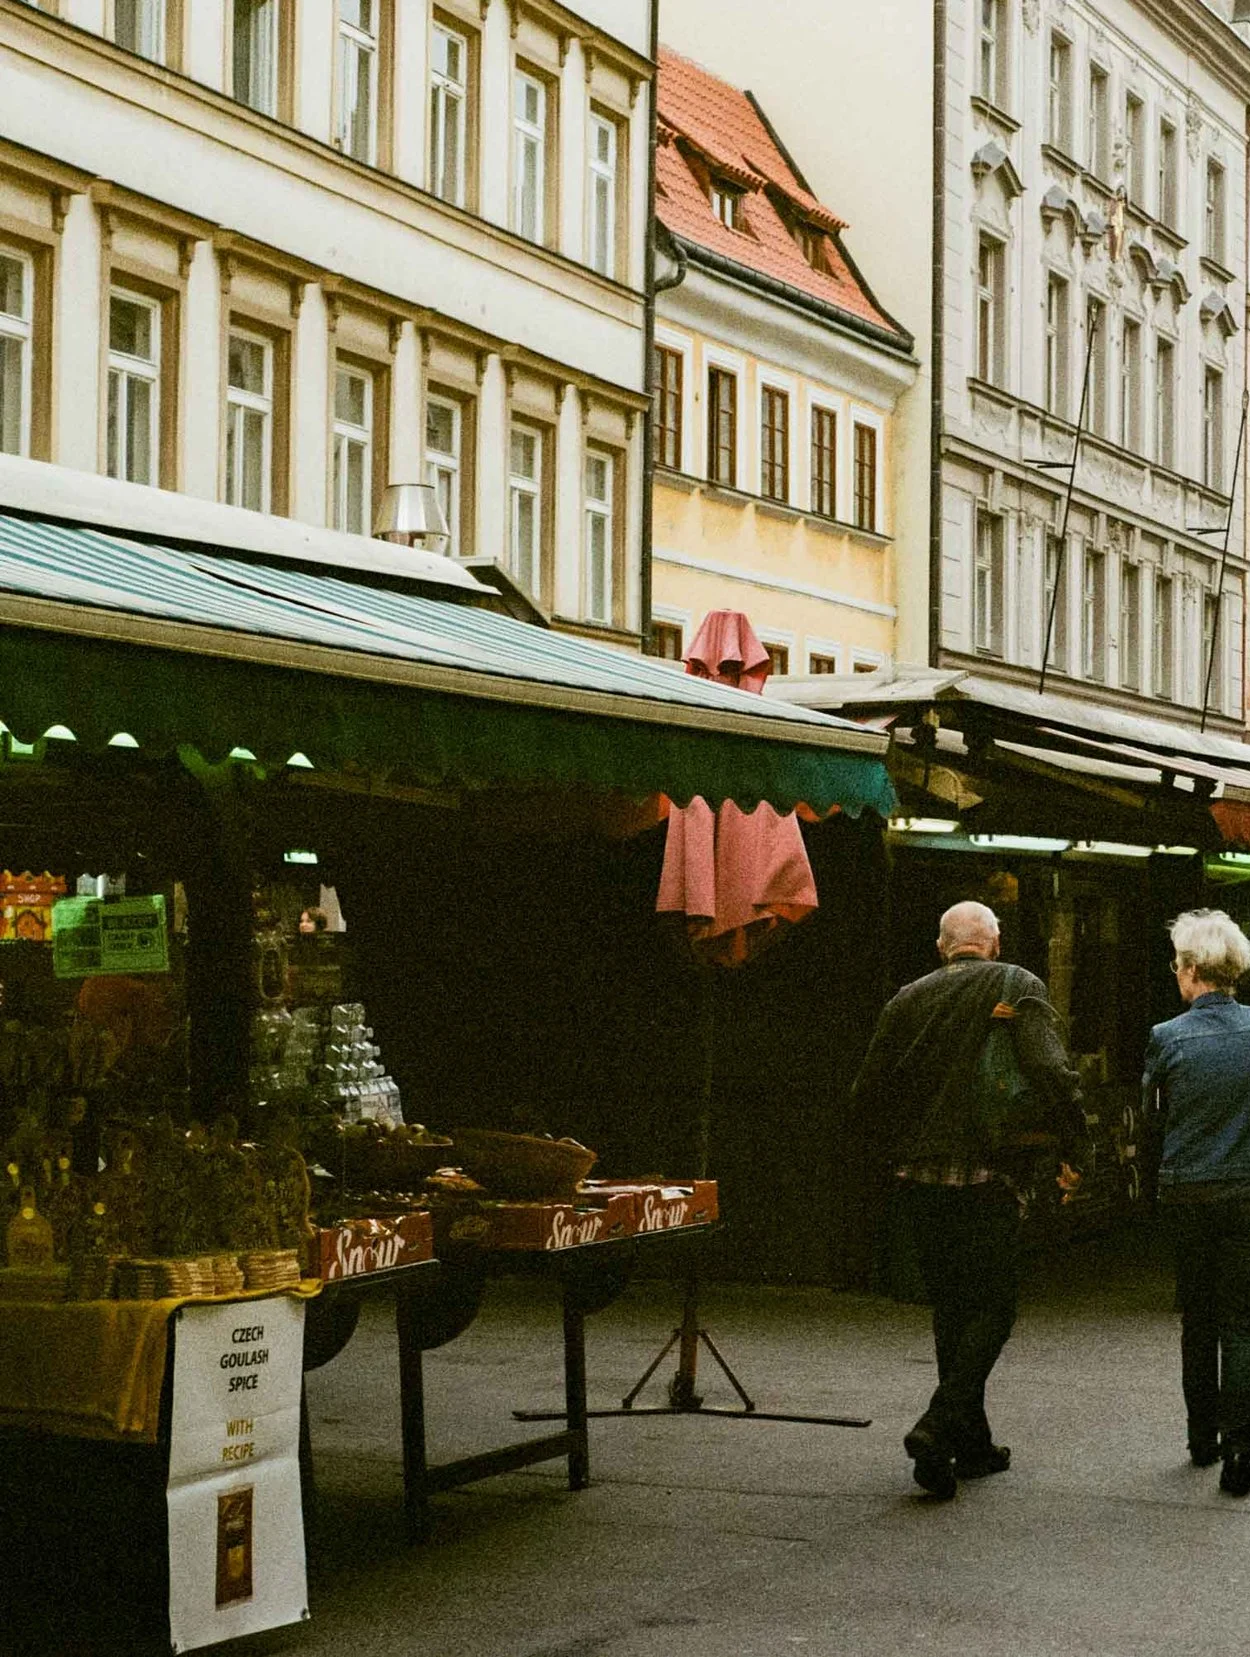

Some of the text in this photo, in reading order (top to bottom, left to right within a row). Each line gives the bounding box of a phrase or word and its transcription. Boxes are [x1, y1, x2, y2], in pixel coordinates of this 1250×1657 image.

[231, 1325, 265, 1344] CZECH
[220, 1348, 270, 1369] GOULASH
[228, 1373, 259, 1393] SPICE
[225, 1418, 254, 1437] WITH
[222, 1442, 255, 1462] RECIPE
